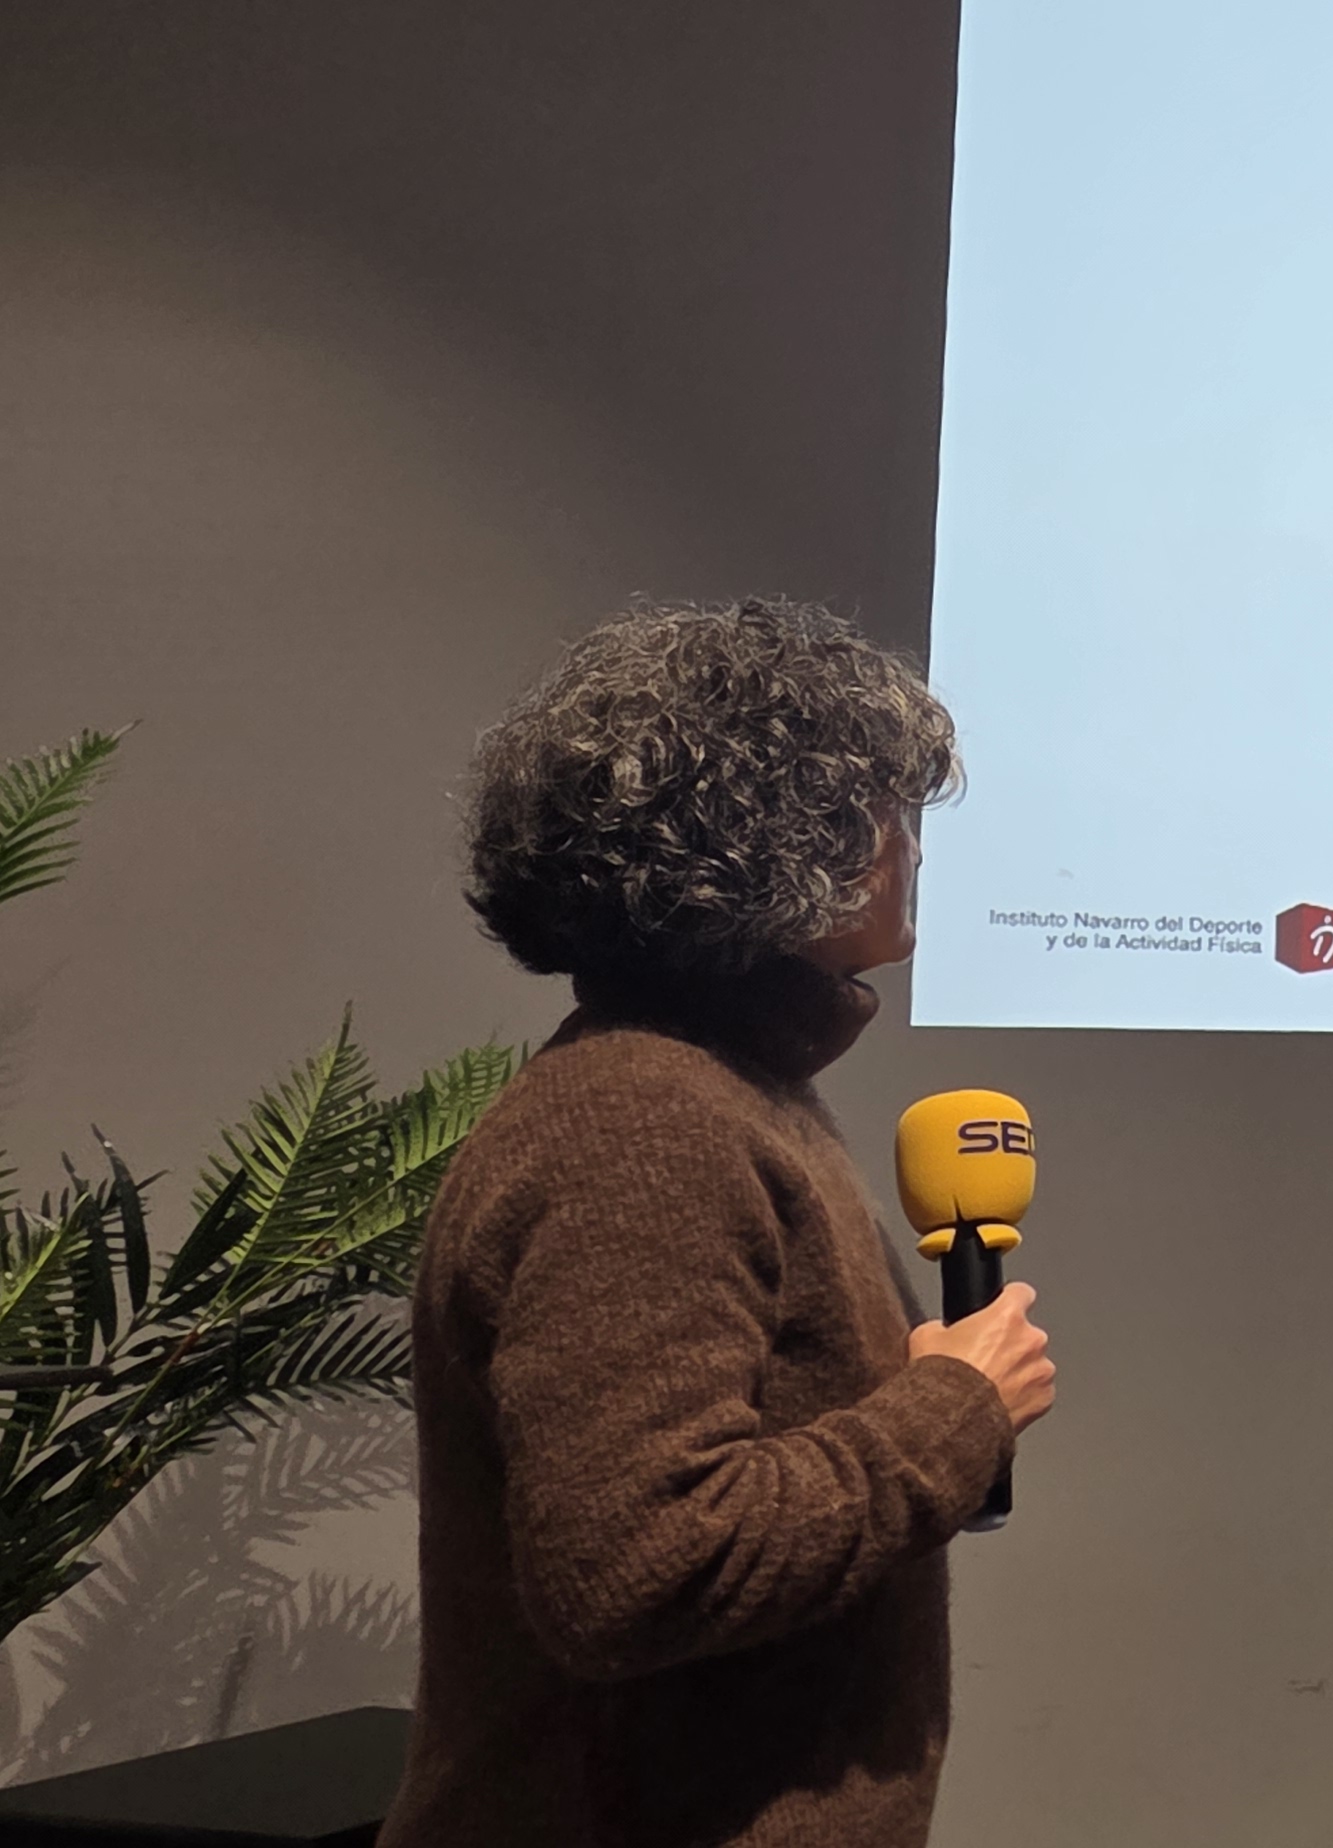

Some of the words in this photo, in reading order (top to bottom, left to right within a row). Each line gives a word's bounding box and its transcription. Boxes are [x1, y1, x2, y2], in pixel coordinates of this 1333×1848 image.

[989, 909, 1068, 928] Instituto
[1074, 912, 1149, 931] Navarro
[1155, 916, 1183, 932] del
[1189, 917, 1263, 936] Deporte
[1046, 934, 1058, 951] y
[1063, 932, 1088, 949] de
[1093, 933, 1111, 949] la
[1115, 934, 1202, 952] Actividad
[1207, 935, 1263, 954] Física
[957, 1120, 1036, 1157] SE
